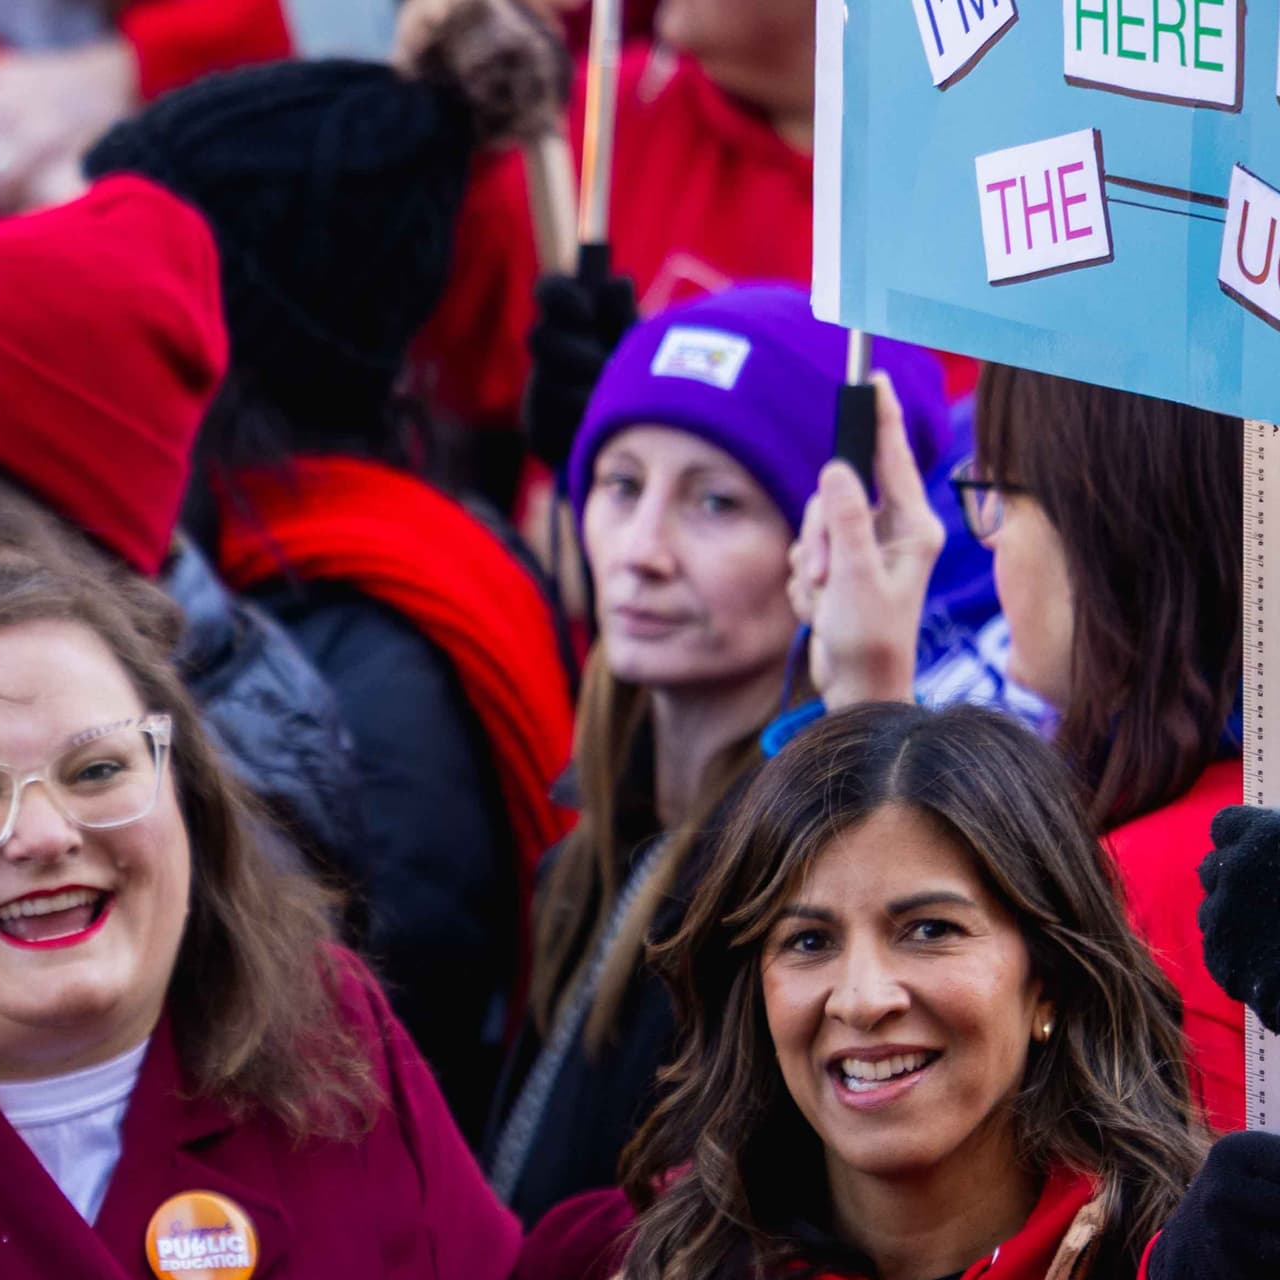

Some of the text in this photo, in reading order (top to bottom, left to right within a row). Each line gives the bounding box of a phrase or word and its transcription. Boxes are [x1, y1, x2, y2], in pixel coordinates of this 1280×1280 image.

[923, 0, 1225, 72] IM HERE
[986, 161, 1280, 285] THE U
[157, 1235, 245, 1260] PUBLIC
[159, 1252, 250, 1271] EDUCATION
